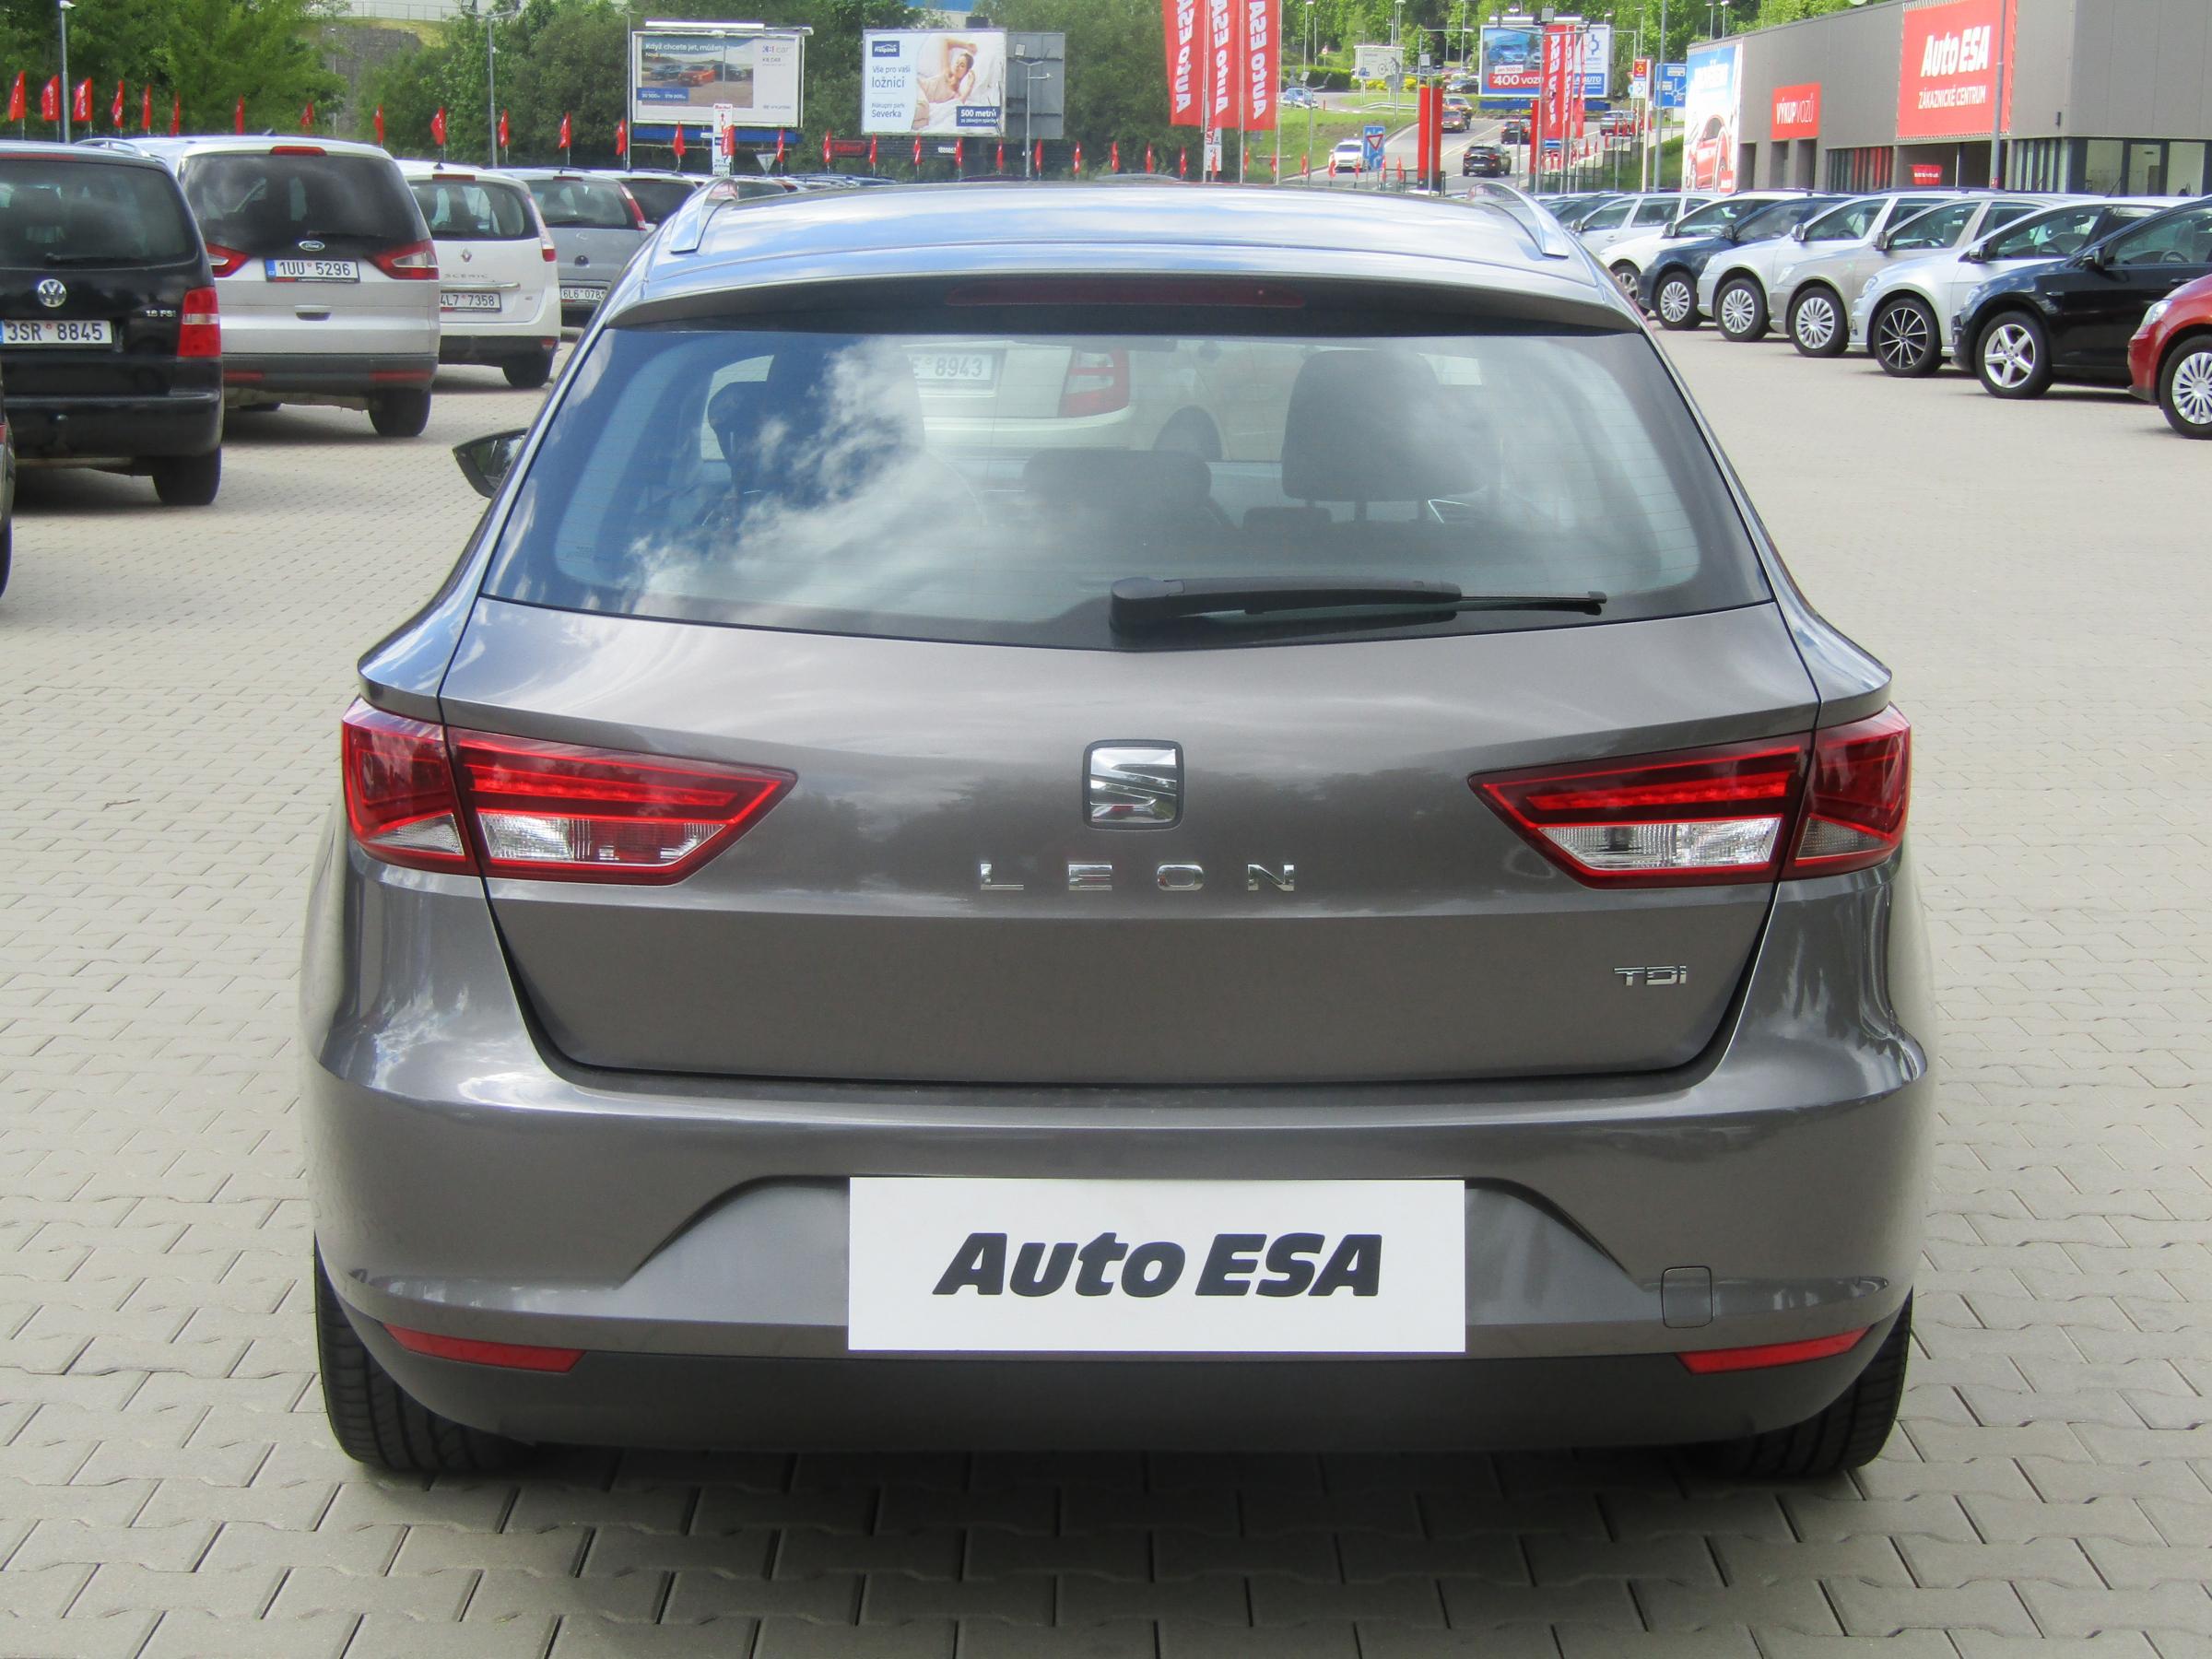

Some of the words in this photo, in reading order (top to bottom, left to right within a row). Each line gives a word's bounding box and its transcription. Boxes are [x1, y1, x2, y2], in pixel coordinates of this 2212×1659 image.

[1920, 31, 1960, 77] Auto
[1959, 25, 1991, 74] ESA
[872, 76, 905, 88] ložnici
[1956, 86, 1986, 107] CENTRUM
[871, 109, 901, 118] Severka
[960, 109, 973, 117] 500
[279, 262, 305, 276] 1UU
[315, 263, 350, 276] 5296
[468, 294, 495, 307] 7358
[7, 323, 42, 342] 3SR
[57, 323, 103, 341] 8845
[935, 356, 983, 378] 8943
[980, 863, 1295, 892] LEON
[1614, 965, 1687, 987] TDI
[931, 1231, 1186, 1298] Auto
[1194, 1231, 1382, 1298] ESA
